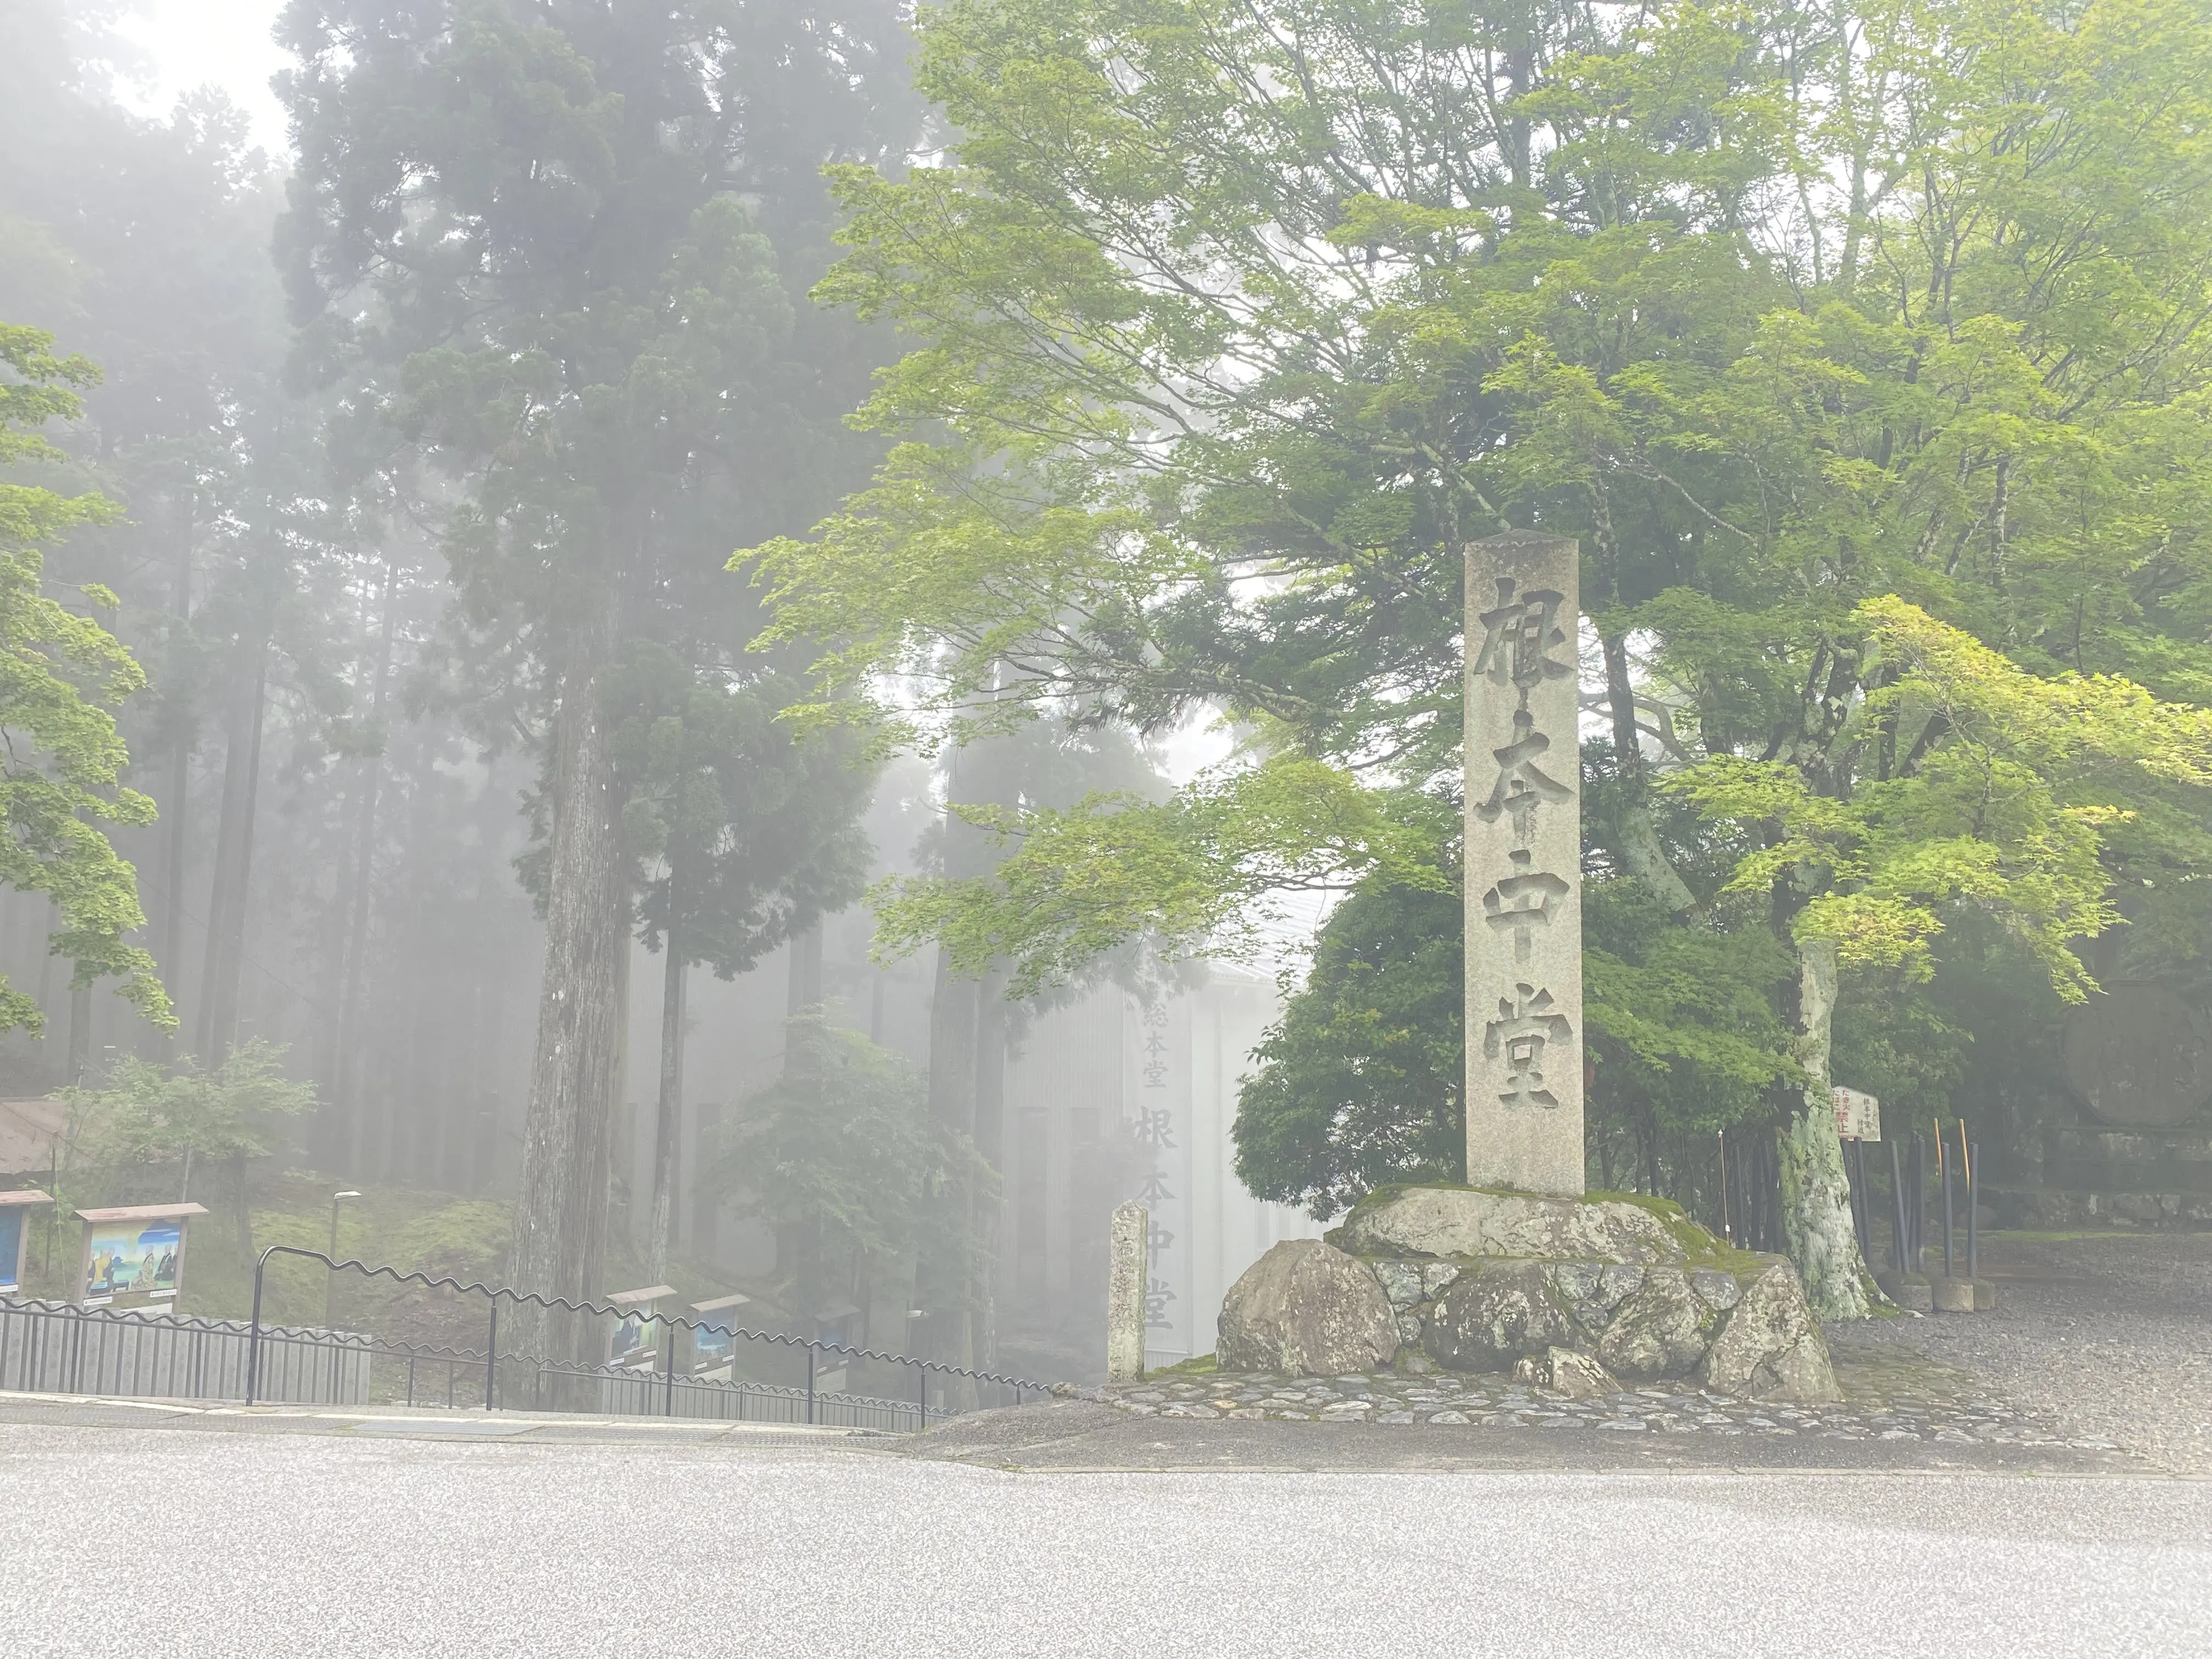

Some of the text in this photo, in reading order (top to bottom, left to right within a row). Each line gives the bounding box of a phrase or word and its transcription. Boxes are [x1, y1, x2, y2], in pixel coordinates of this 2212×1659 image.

[1474, 577, 1575, 1109] 根本中堂
[1133, 1003, 1178, 1330] 総本堂 根本中堂
[1836, 1111, 1849, 1133] 禁止
